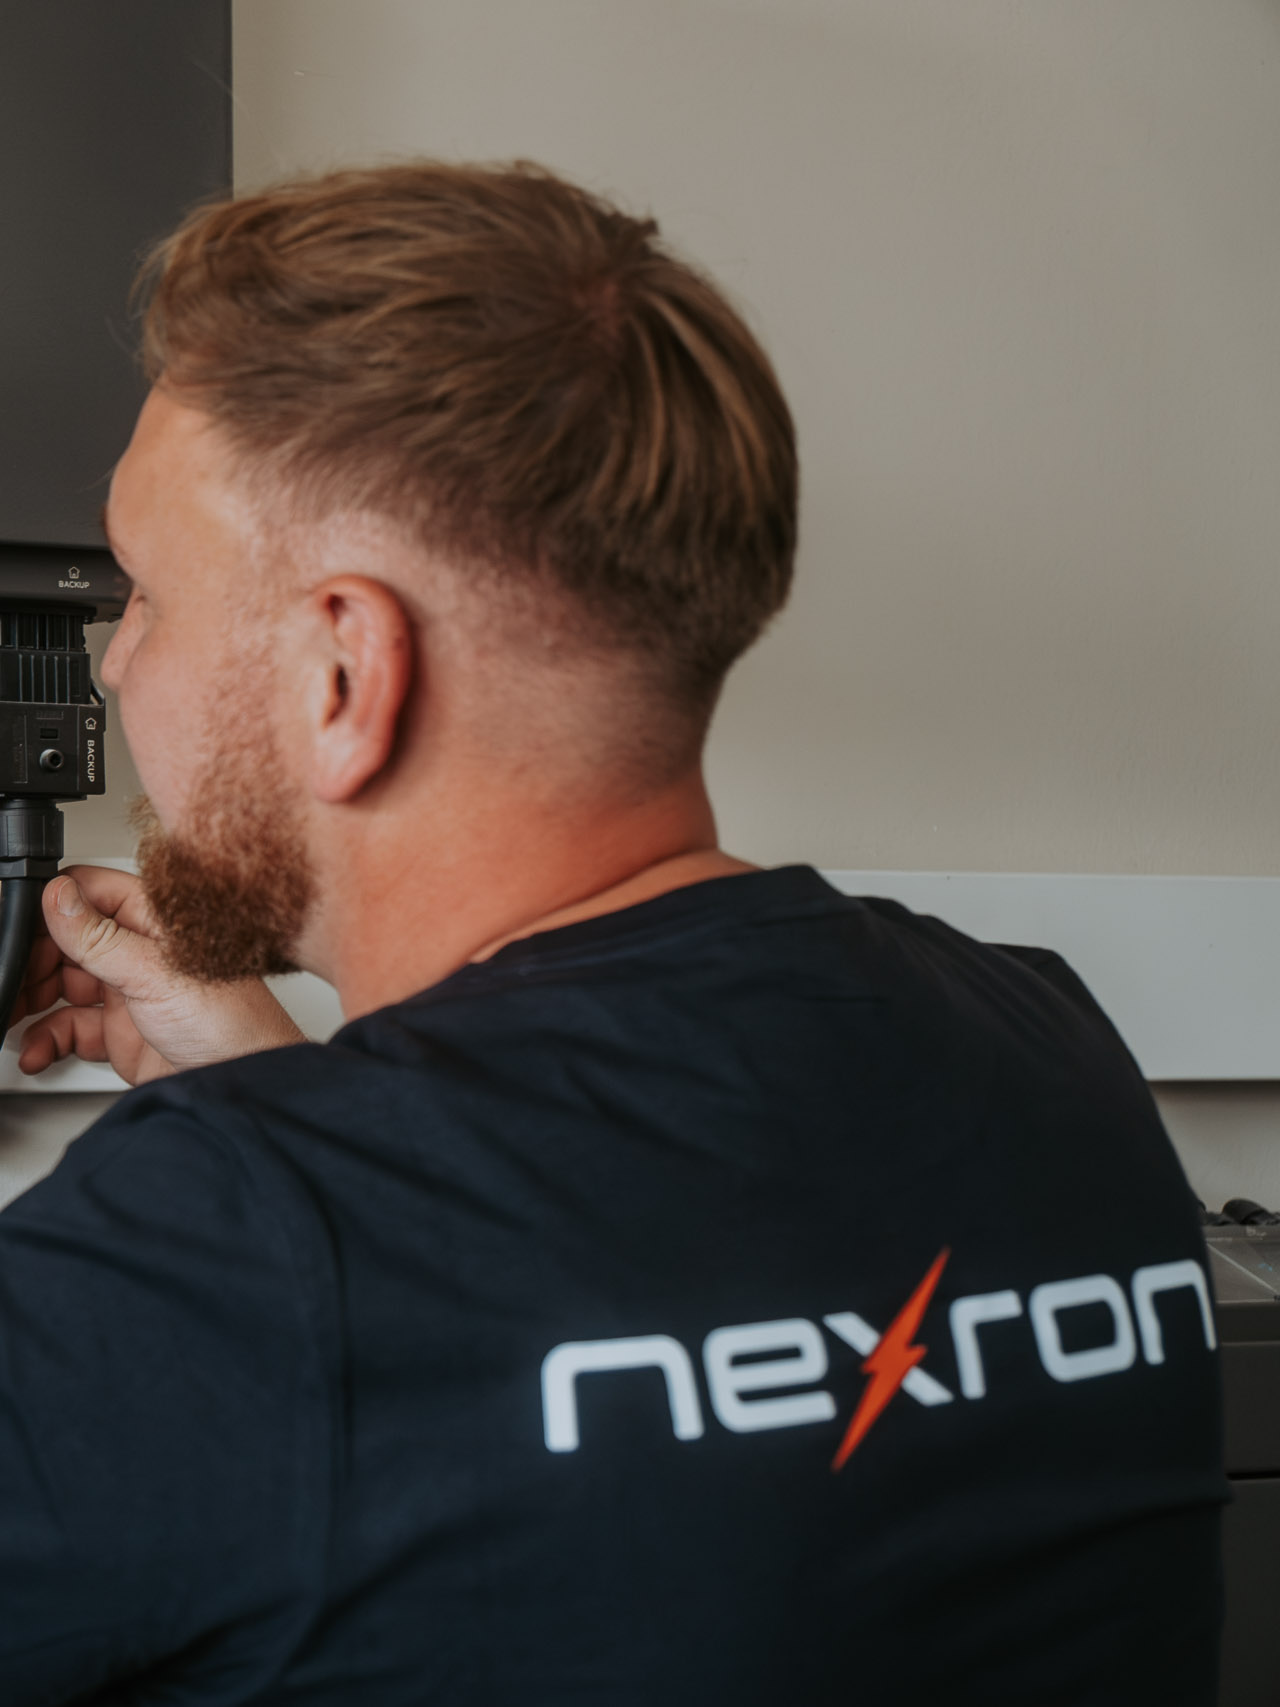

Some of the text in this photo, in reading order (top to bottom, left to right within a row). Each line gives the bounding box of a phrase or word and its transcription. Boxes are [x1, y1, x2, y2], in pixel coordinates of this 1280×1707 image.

[58, 580, 90, 589] BACKUP
[87, 740, 95, 783] BACKUP
[541, 1246, 1217, 1472] nexron
